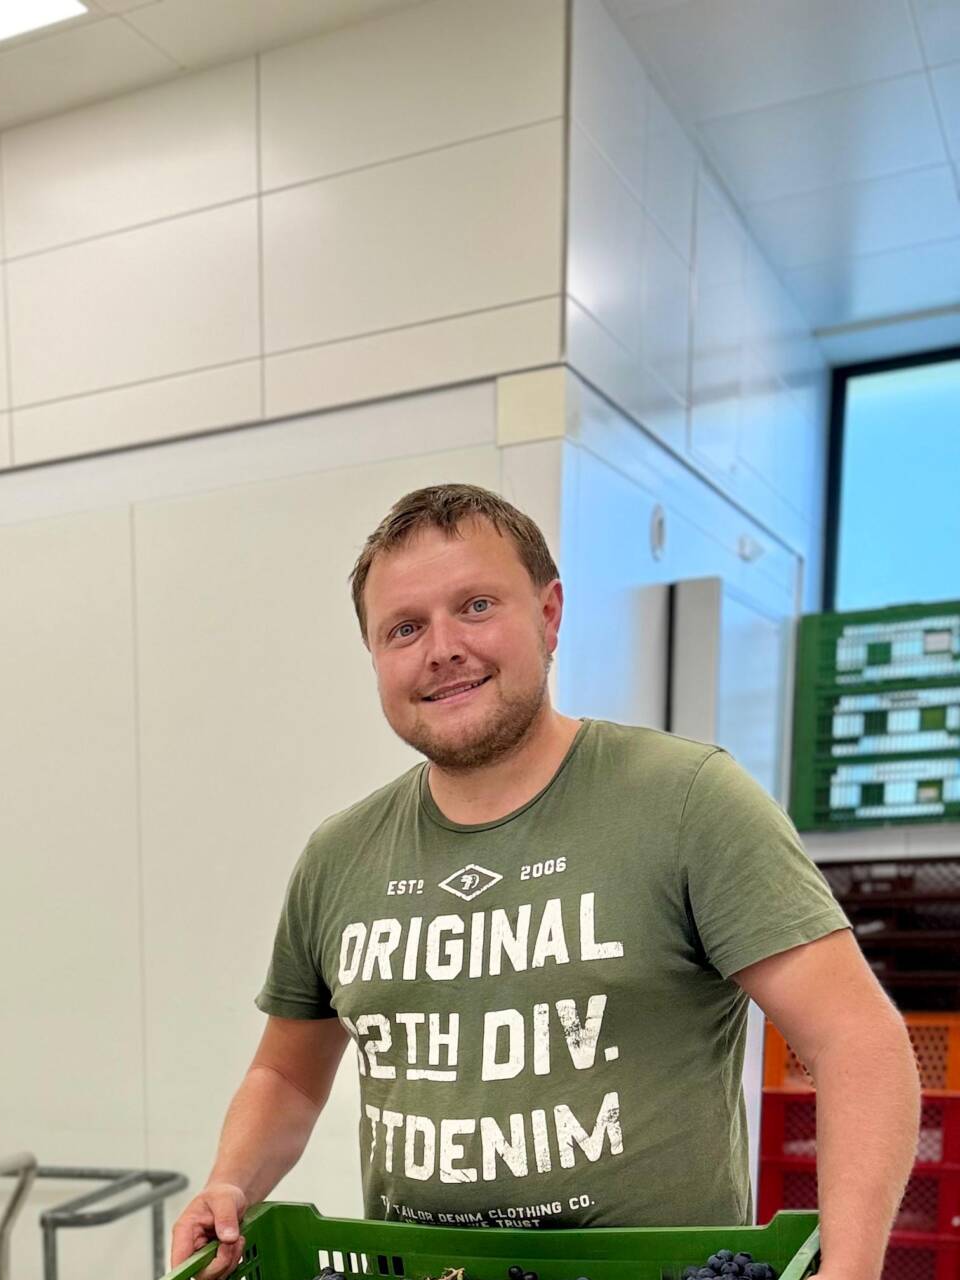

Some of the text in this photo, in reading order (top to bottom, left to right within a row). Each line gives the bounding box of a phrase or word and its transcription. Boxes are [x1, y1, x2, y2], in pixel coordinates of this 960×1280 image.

[520, 856, 567, 880] 2006
[338, 892, 625, 986] ORIGINAL
[481, 994, 620, 1081] DIV.
[392, 1204, 435, 1222] TAILOR
[438, 1211, 484, 1223] DENIM
[488, 1201, 562, 1219] CLOTHING
[569, 1194, 595, 1210] CO.
